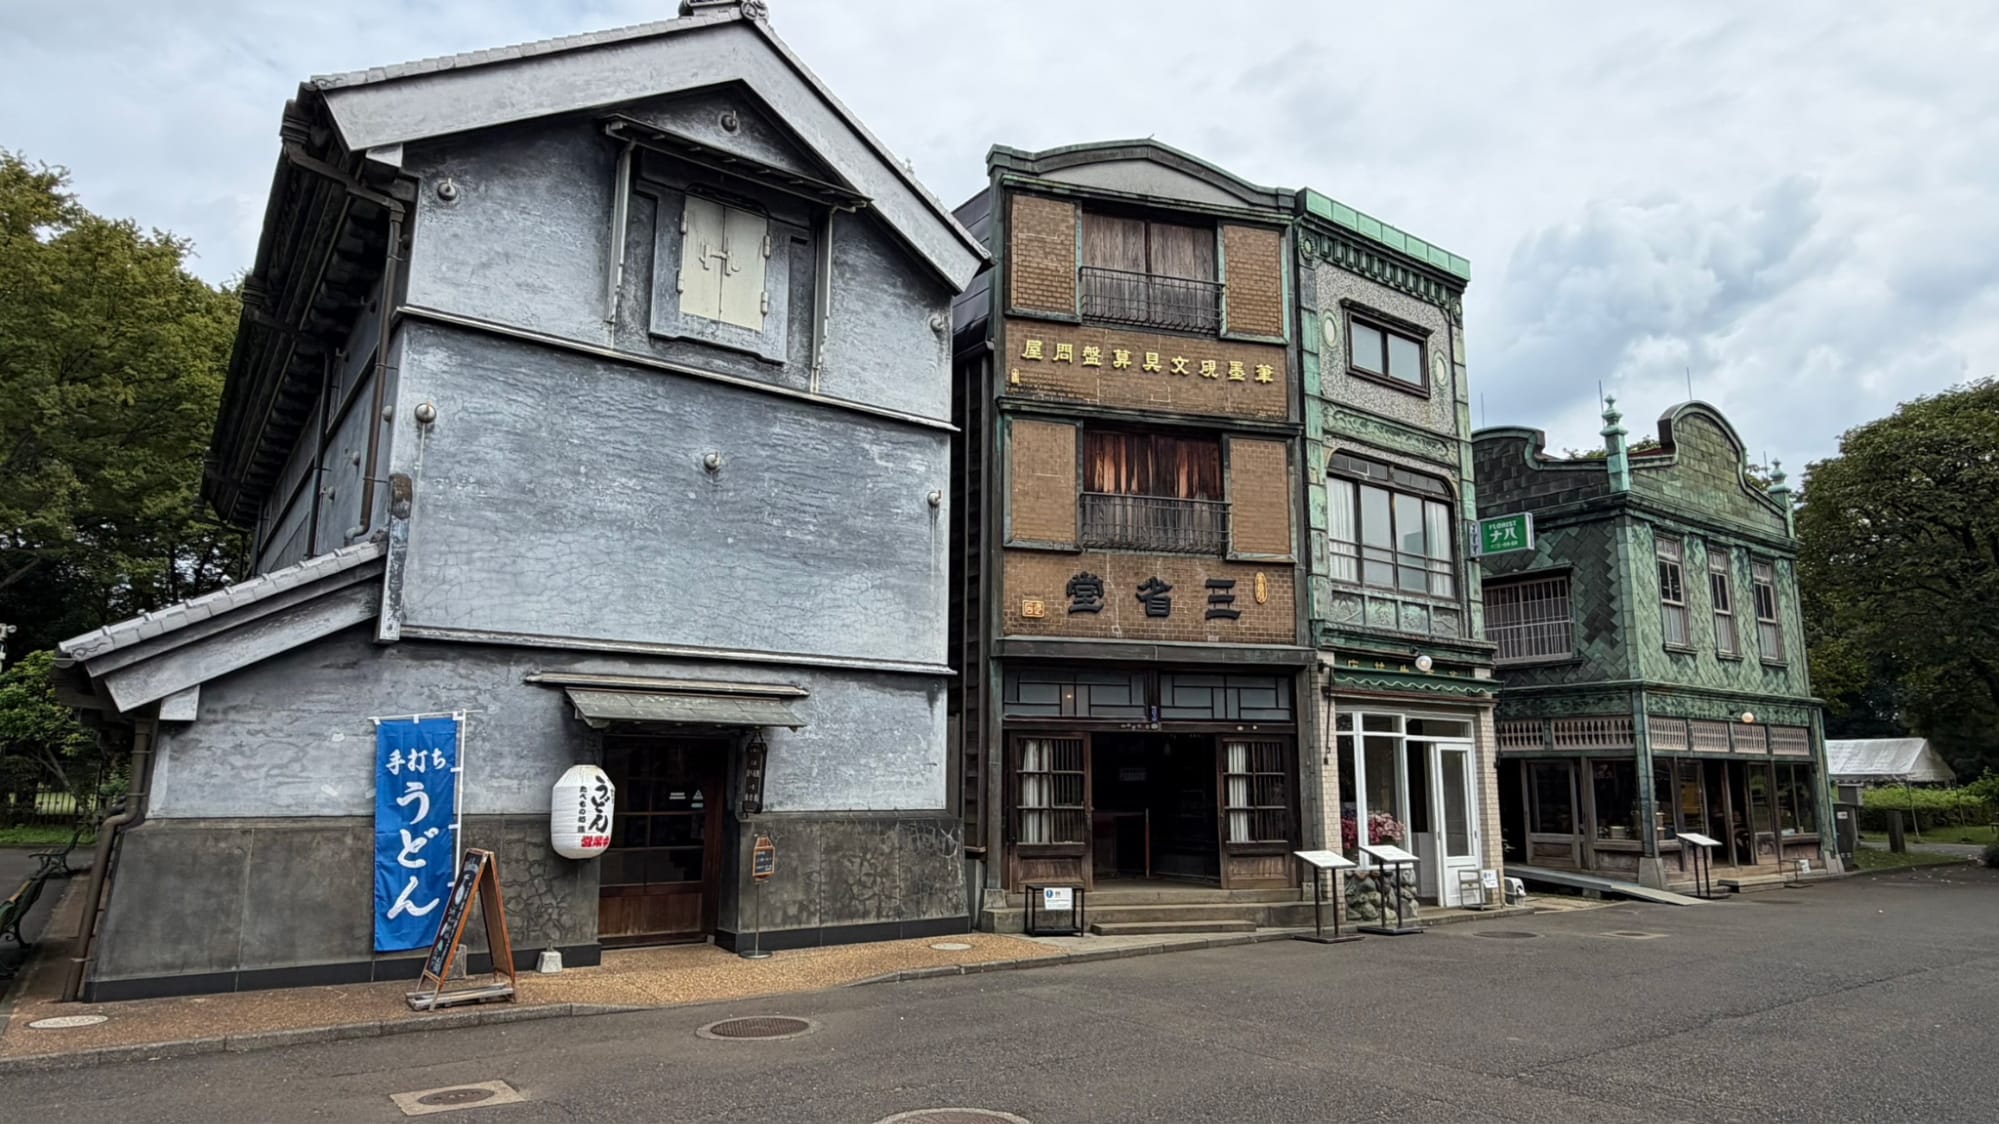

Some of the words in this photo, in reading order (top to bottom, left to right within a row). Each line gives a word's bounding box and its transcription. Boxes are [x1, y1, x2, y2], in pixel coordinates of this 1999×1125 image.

[1488, 520, 1517, 530] FLORIST
[385, 747, 446, 775] 手打ち
[588, 775, 611, 834] うどん
[386, 781, 440, 920] うどん
